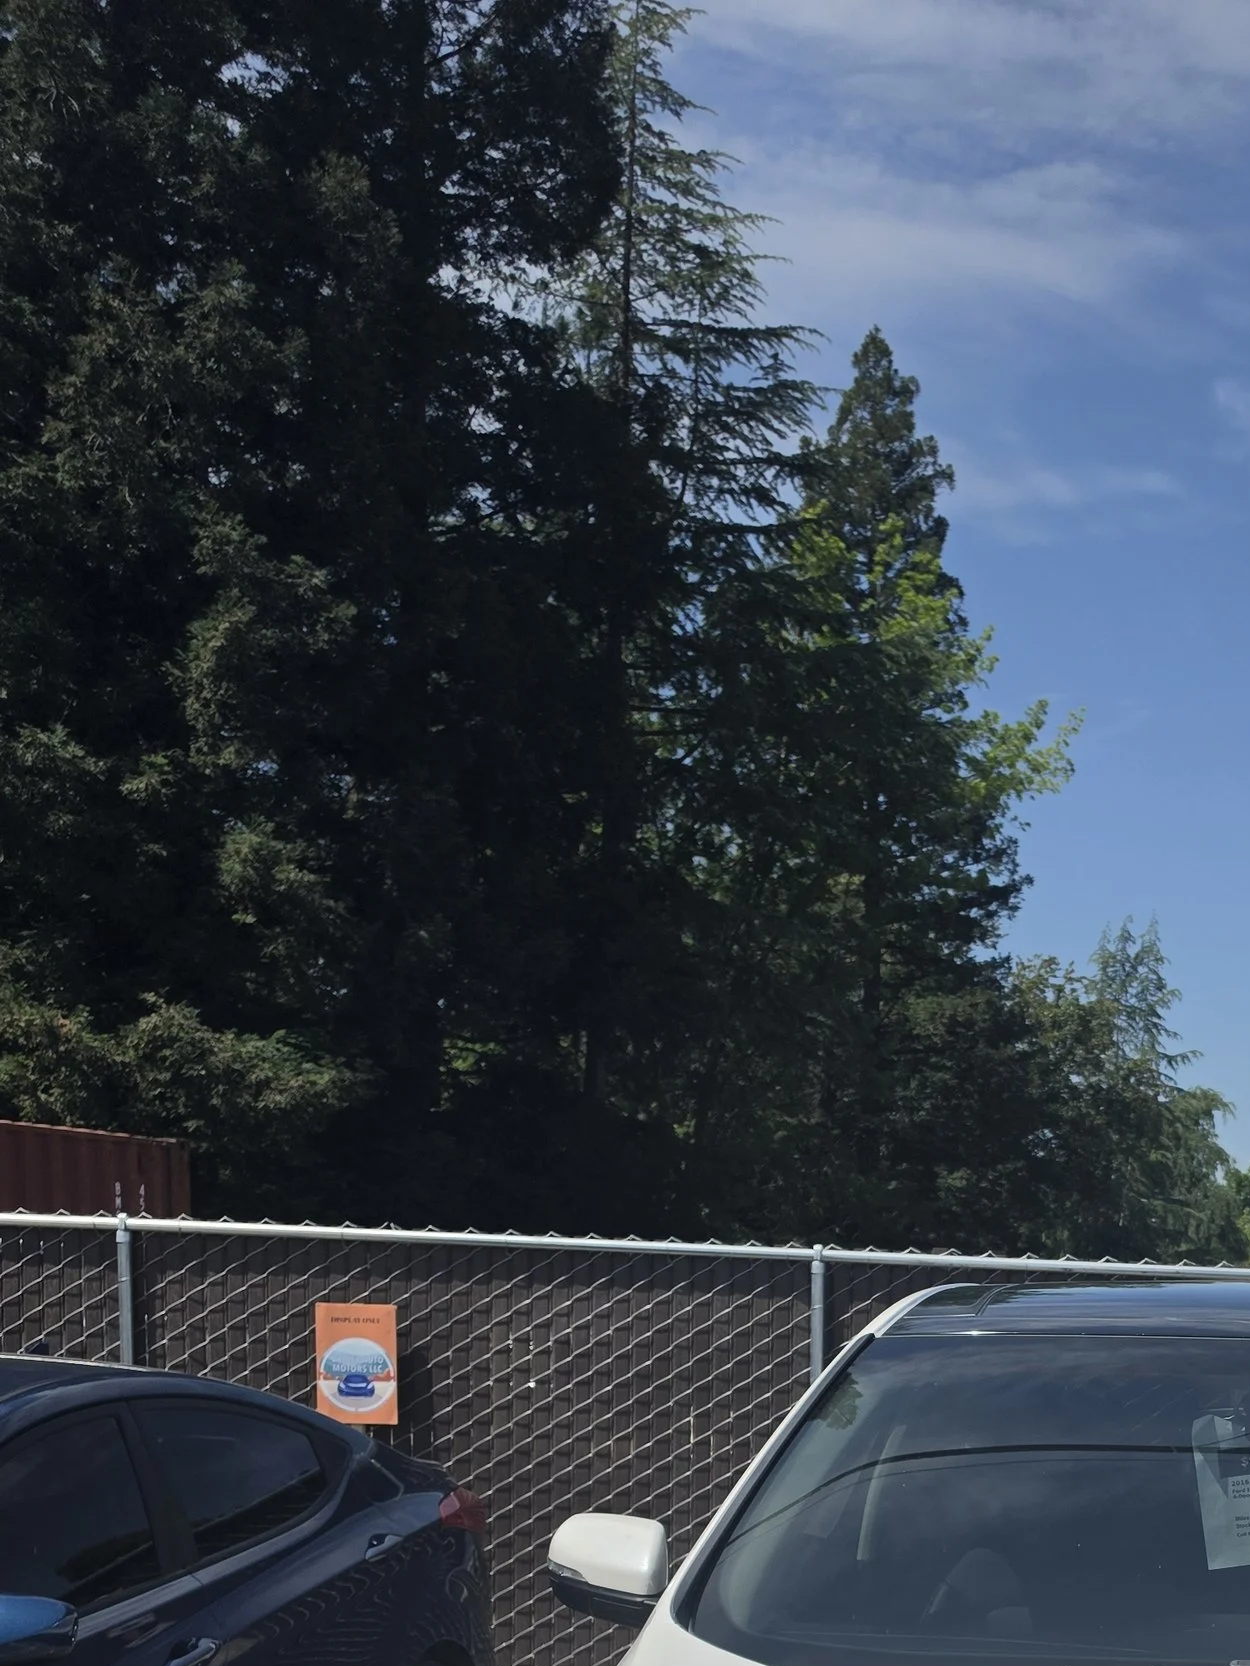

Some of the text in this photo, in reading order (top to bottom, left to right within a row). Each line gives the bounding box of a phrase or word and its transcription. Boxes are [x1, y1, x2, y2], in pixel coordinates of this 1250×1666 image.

[332, 1363, 383, 1373] MOTORS LLC
[1231, 1479, 1250, 1487] 2016
